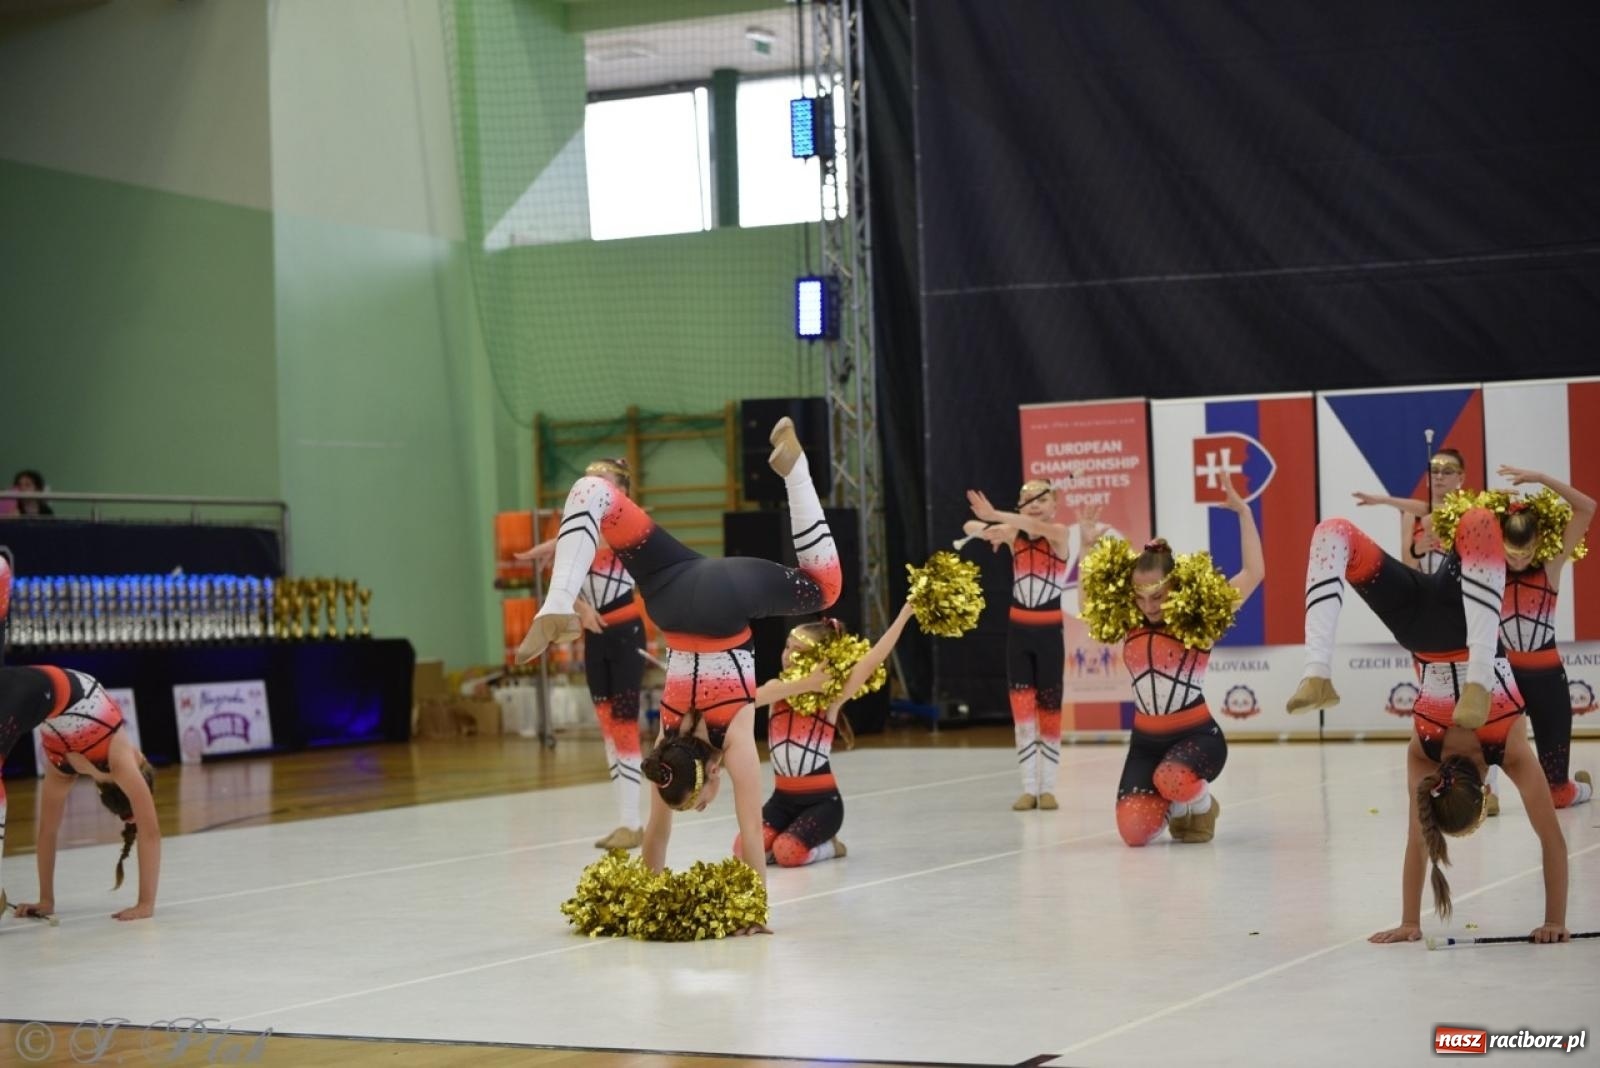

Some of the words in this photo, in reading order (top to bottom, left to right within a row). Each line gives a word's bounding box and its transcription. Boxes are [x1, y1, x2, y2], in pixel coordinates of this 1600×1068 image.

[1045, 440, 1123, 457] EUROPEAN
[1031, 456, 1140, 475] CHAMPIONSHIP
[1065, 491, 1111, 508] SPORT
[1208, 660, 1271, 672] SLOVAKIA
[1348, 657, 1391, 670] CZECH
